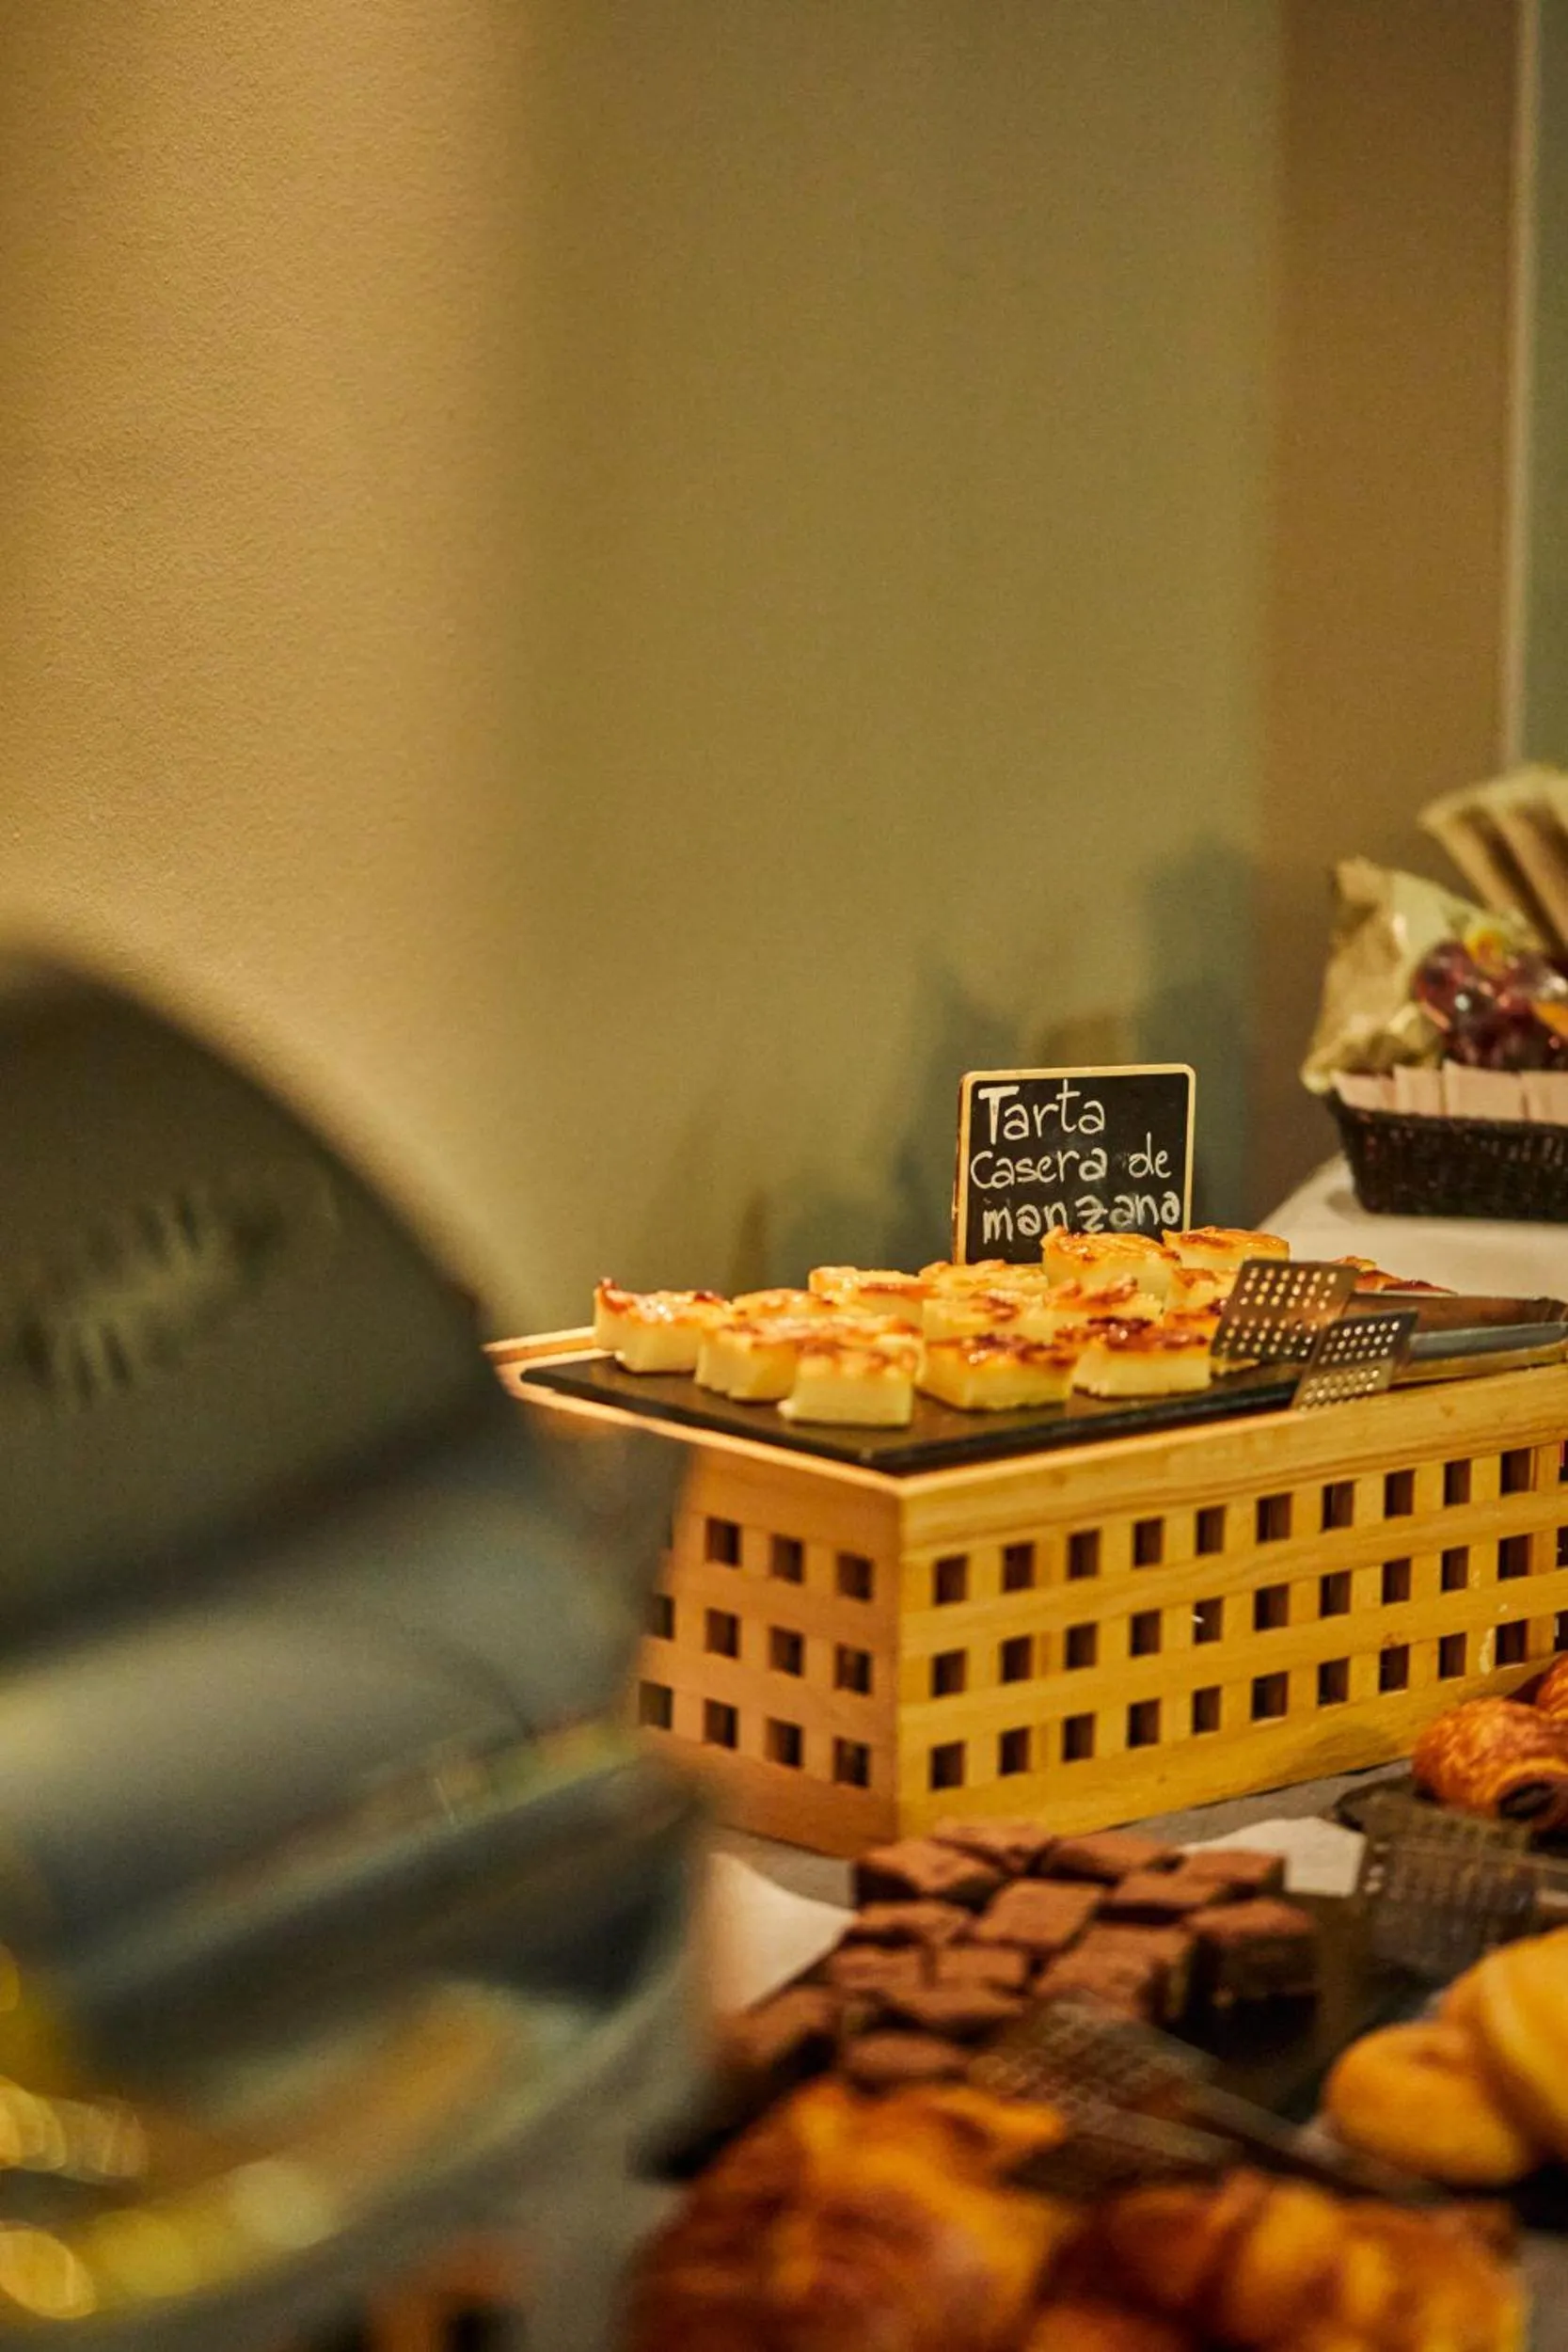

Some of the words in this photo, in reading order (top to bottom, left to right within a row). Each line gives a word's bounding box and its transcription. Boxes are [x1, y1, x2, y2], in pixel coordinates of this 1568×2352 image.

[978, 1078, 1105, 1145] Tarta
[1128, 1132, 1172, 1179] de
[983, 1191, 1180, 1245] manzana
